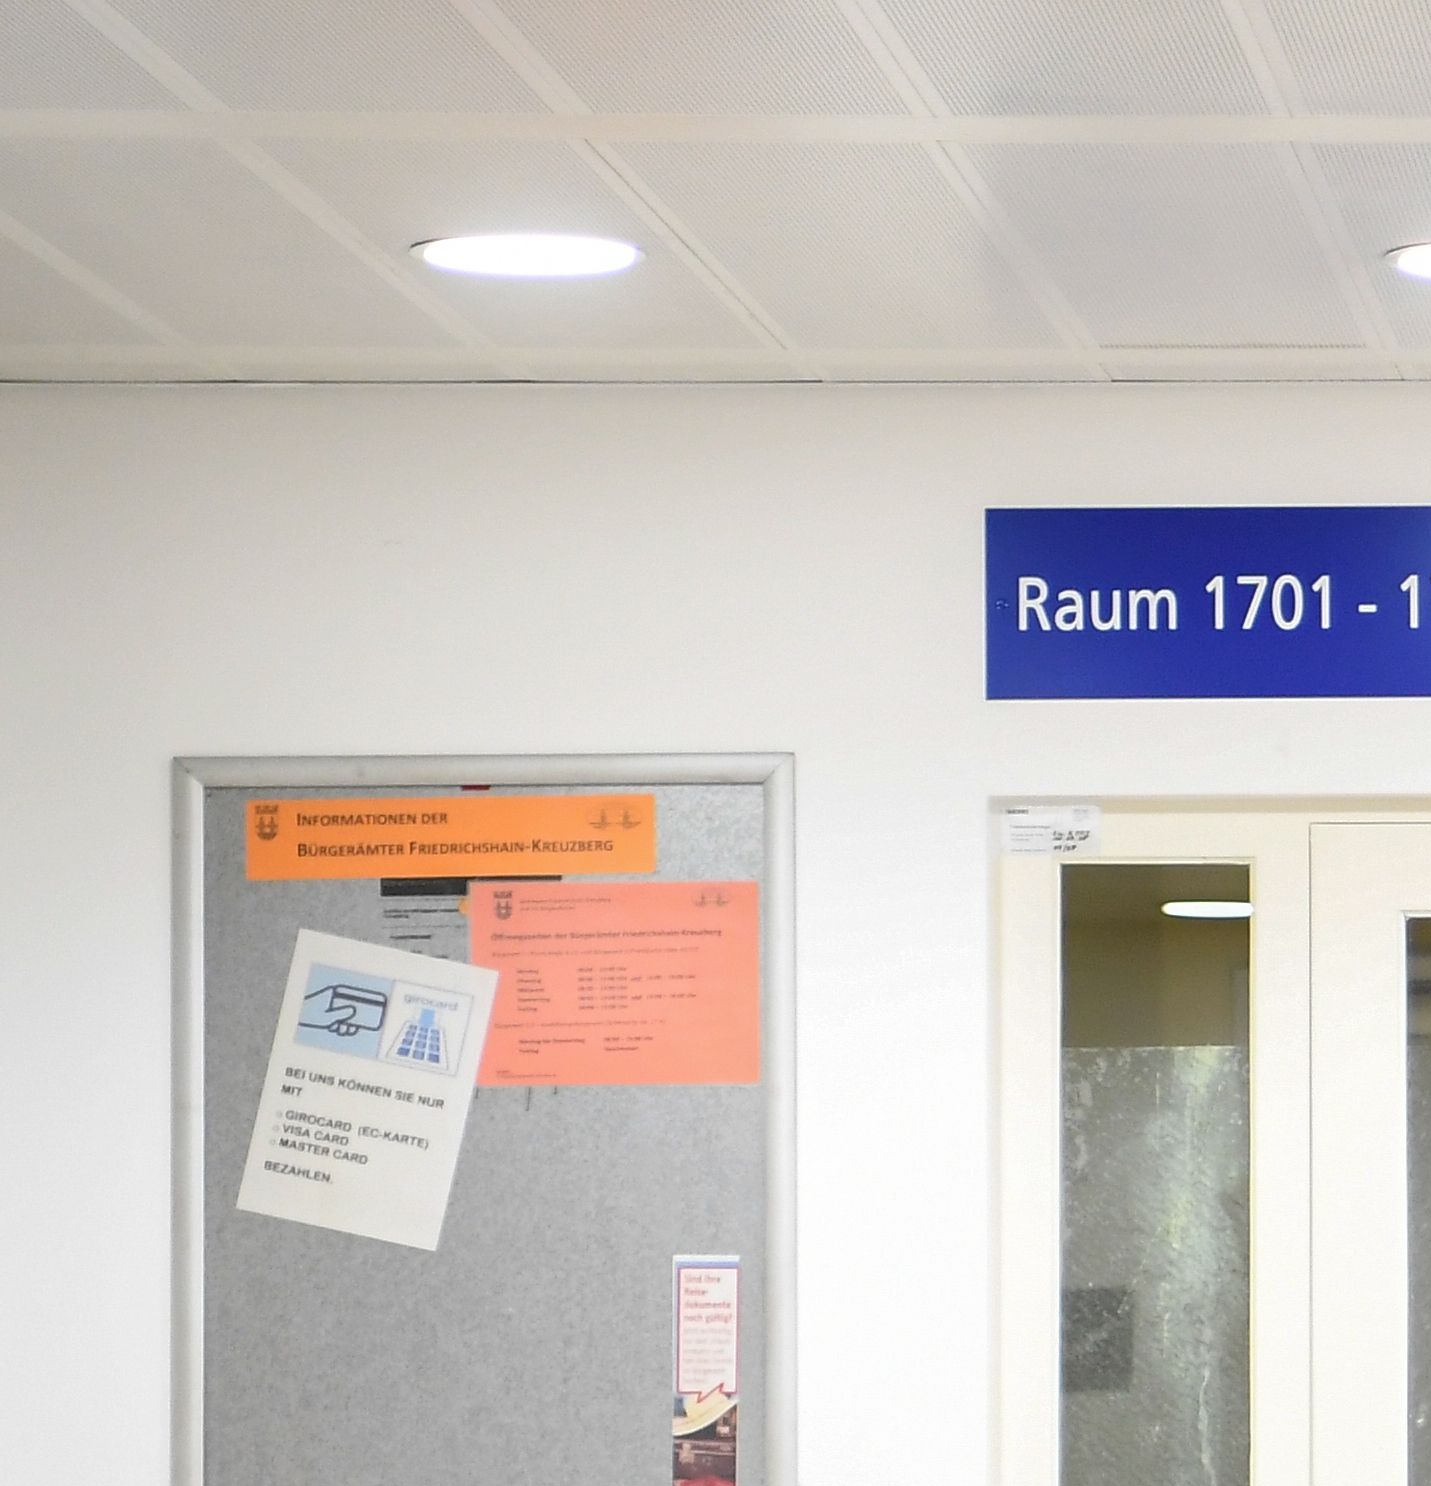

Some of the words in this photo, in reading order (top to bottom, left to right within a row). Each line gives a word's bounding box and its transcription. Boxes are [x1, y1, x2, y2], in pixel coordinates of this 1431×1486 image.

[1018, 576, 1177, 631] Raum
[1205, 574, 1331, 631] 1701
[1358, 604, 1378, 613] -
[281, 1084, 303, 1097] MIT
[285, 1067, 306, 1080] BEI
[308, 1072, 335, 1086] UNS
[337, 1077, 392, 1098] KÖNNEN
[395, 1090, 414, 1103] SIE
[417, 1095, 445, 1110] NUR
[283, 1123, 310, 1139] VISA
[314, 1130, 349, 1147] CARD
[285, 1110, 352, 1133] GIROCARD
[357, 1126, 430, 1150] (EC-KARTE)
[278, 1138, 330, 1157] MASTER
[332, 1149, 369, 1165] CARD
